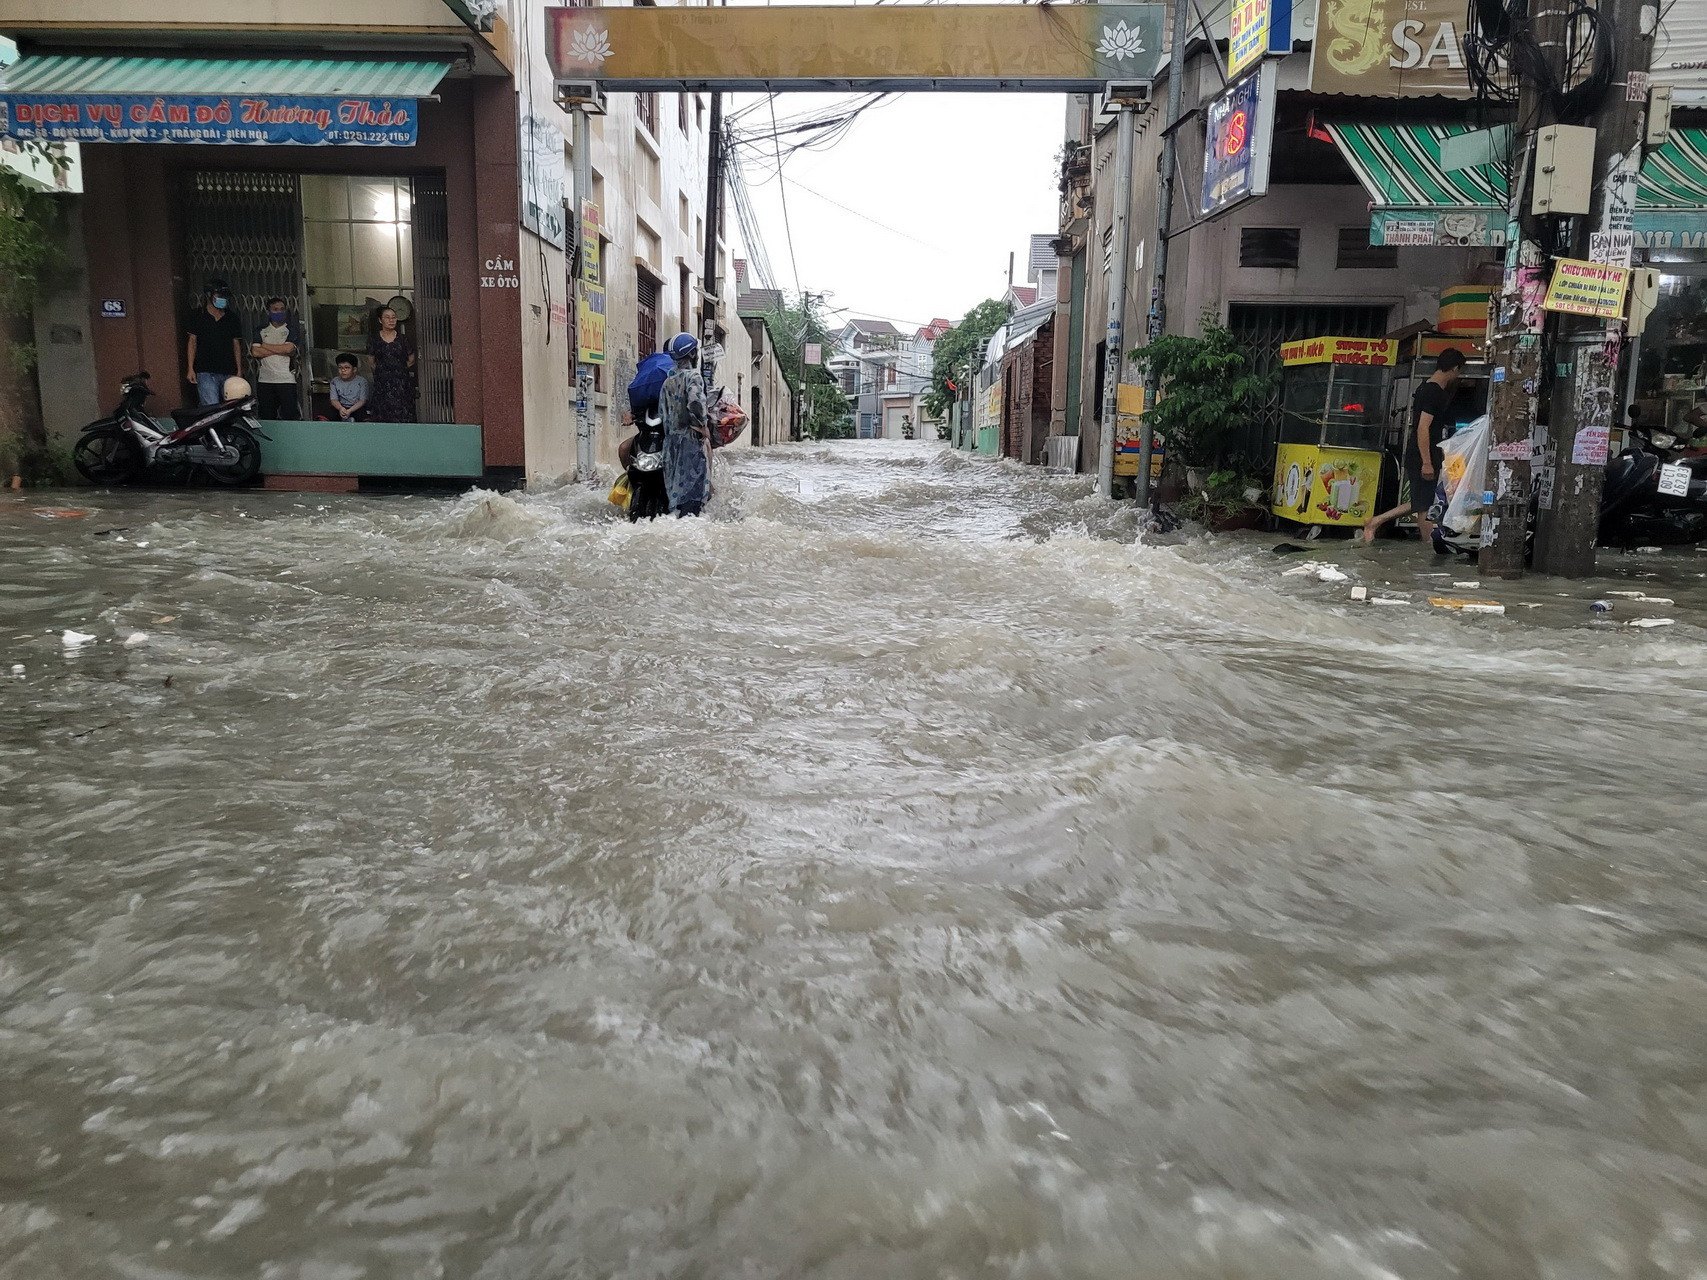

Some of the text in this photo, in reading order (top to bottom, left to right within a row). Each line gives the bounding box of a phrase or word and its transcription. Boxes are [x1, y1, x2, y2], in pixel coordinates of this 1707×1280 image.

[1404, 1, 1427, 11] EST.
[16, 104, 79, 127] DỊCH
[86, 104, 122, 128] VỤ
[129, 97, 190, 123] CẦM
[196, 98, 231, 124] ĐỒ
[240, 99, 333, 130] Hương
[337, 100, 410, 126] Thảo
[149, 128, 157, 138] 2
[485, 254, 514, 270] CẦM
[480, 274, 519, 288] XE ÔTÔ
[1336, 340, 1368, 352] SINH
[1332, 352, 1369, 365] NƯỚC
